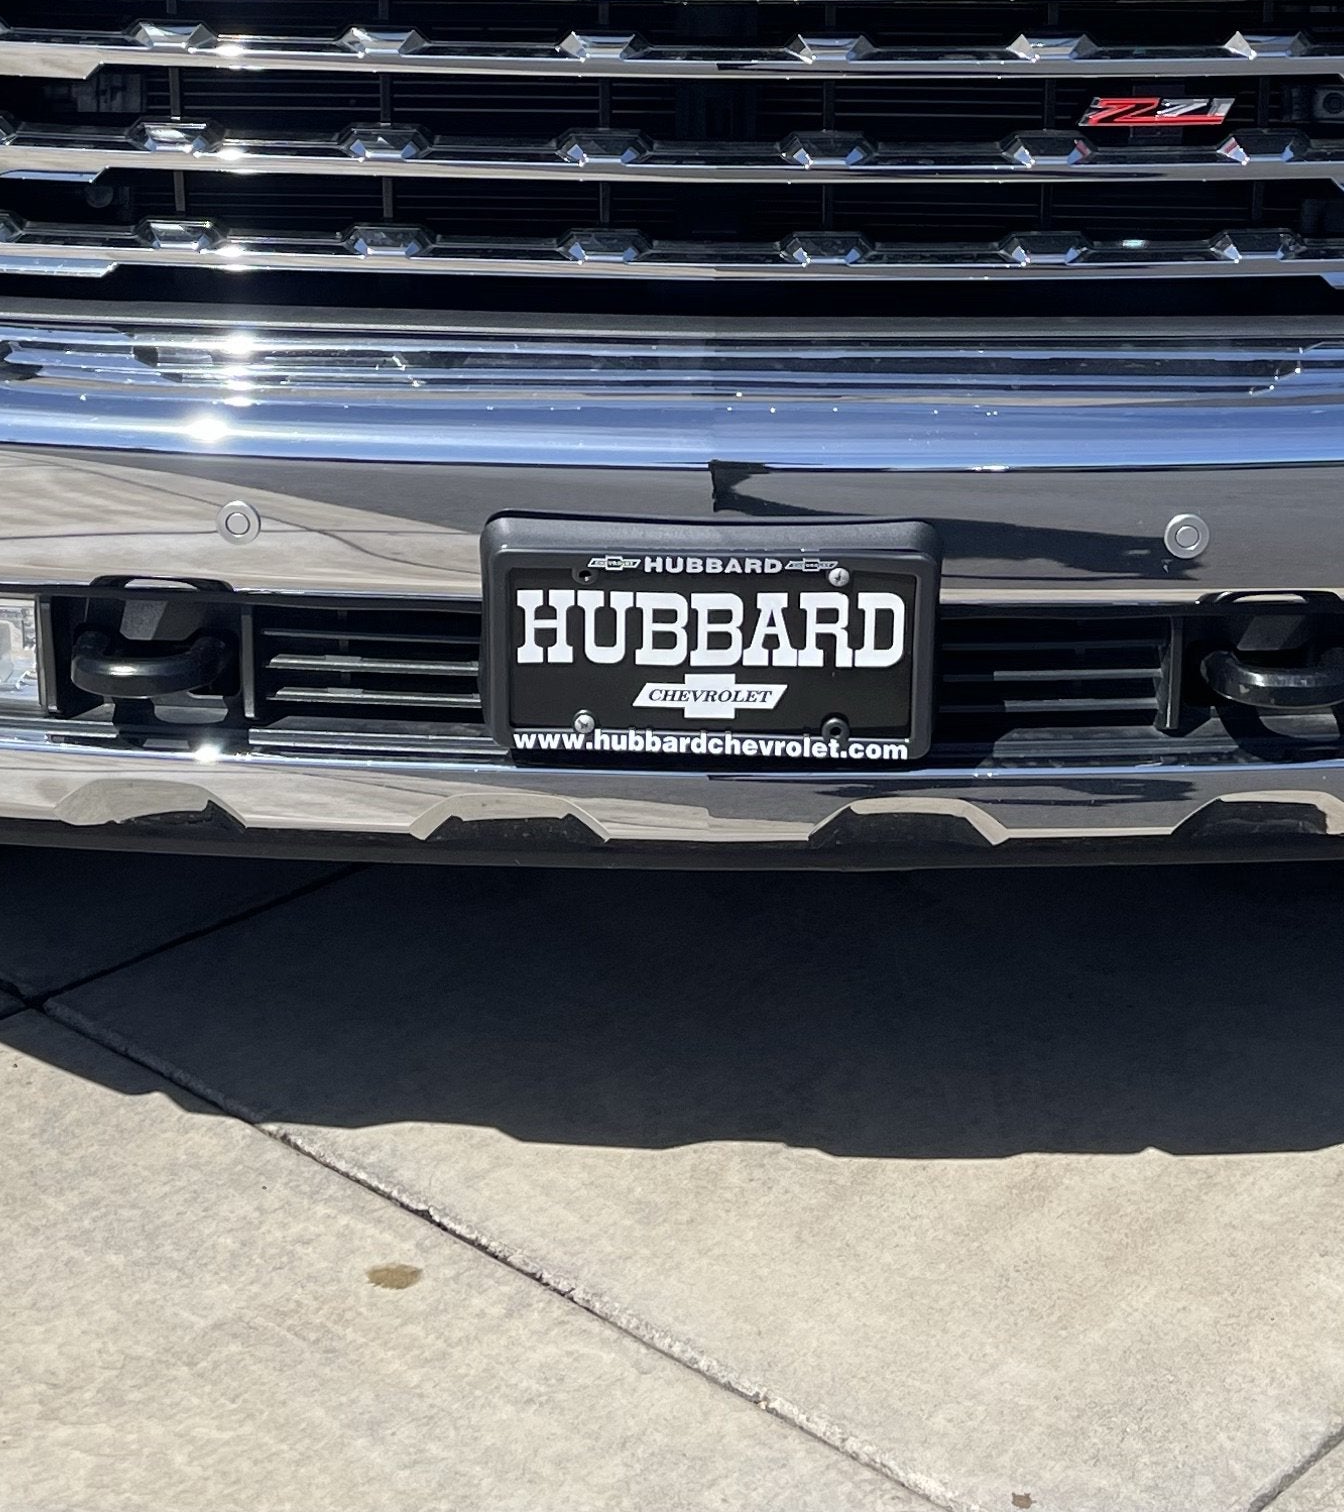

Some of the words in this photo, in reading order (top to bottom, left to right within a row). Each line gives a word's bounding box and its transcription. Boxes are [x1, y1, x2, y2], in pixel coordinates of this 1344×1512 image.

[1078, 96, 1236, 127] Z71
[644, 556, 783, 575] HUBBARD
[516, 588, 906, 669] HUBBARD
[648, 688, 774, 705] CHEVROLET
[513, 728, 909, 761] www.hubbardchevrolet.com
